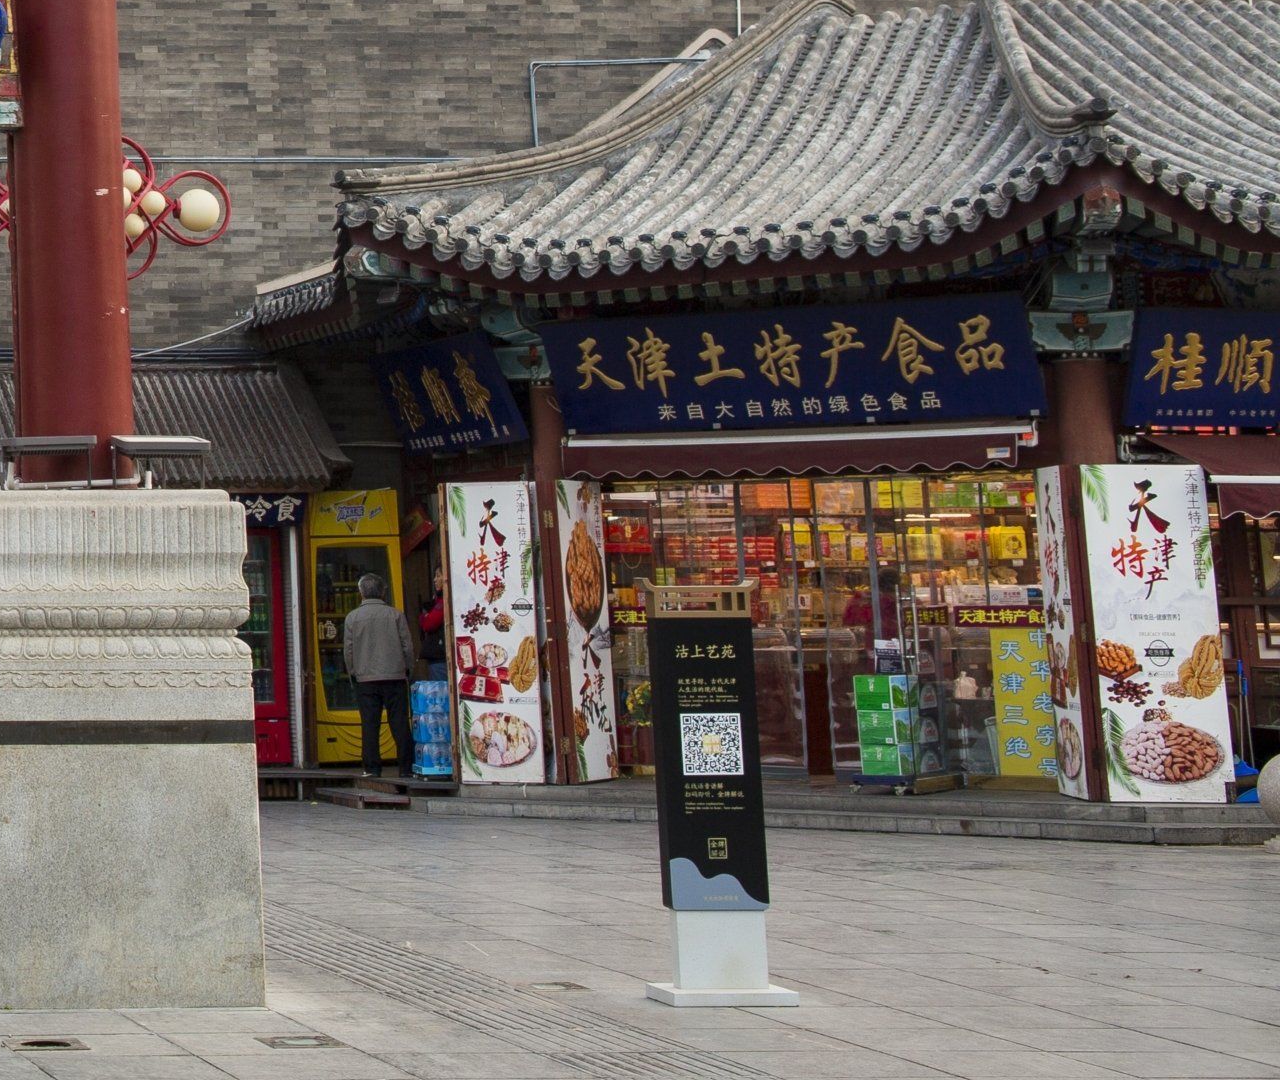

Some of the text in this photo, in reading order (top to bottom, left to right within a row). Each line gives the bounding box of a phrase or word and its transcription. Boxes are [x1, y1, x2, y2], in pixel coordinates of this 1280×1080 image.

[575, 314, 1007, 398] 天津土特产食品
[657, 390, 942, 421] 来自大自然的绿色食品
[236, 495, 302, 522] 冷食
[675, 644, 736, 659] 沽上艺苑
[998, 641, 1031, 758] 天津三绝
